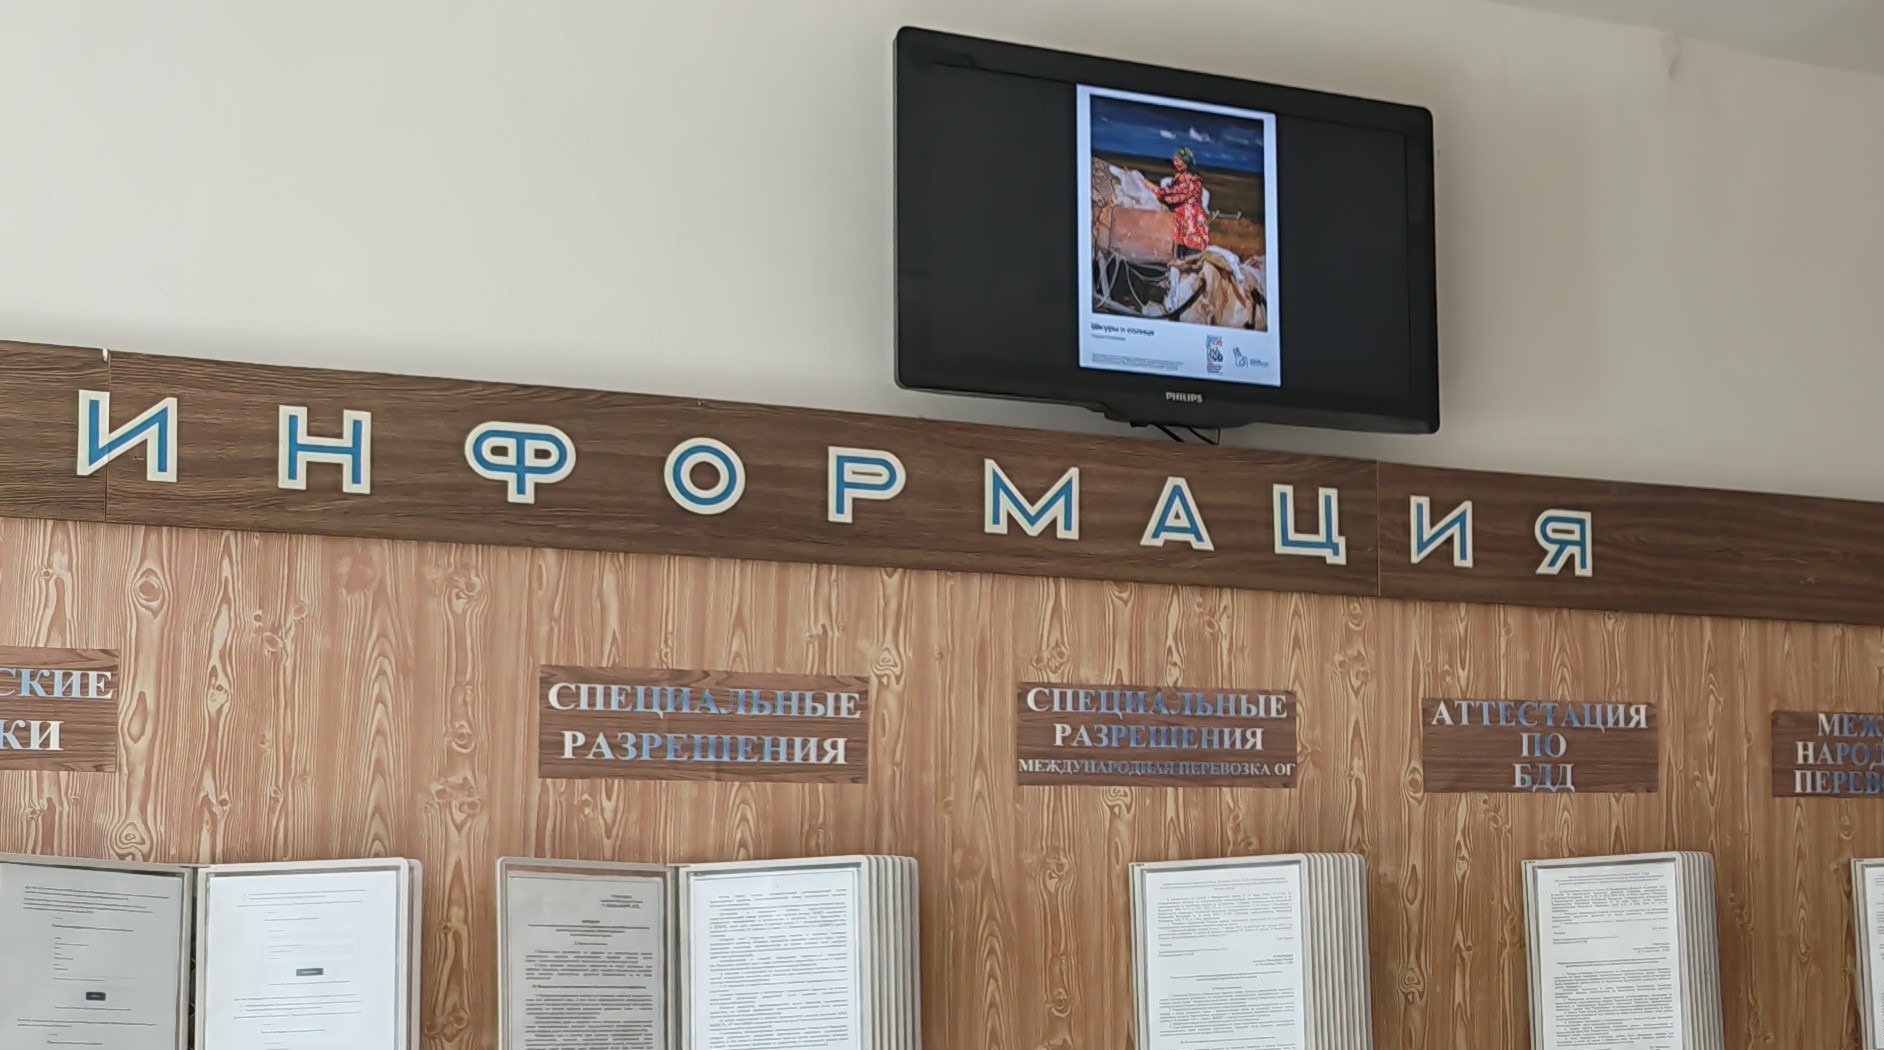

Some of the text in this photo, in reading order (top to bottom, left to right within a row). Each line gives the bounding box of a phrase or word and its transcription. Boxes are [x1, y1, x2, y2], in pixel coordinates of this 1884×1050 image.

[1165, 391, 1203, 404] PHILIPS
[76, 389, 1594, 577] ИНФОРМАЦИЯ
[548, 682, 862, 719] СПЕЦИАЛЬНЫЕ
[1026, 687, 1287, 720] СПЕЦИАЛЬНЫЕ
[1431, 700, 1648, 733] АТТЕСТАЦИЯ
[561, 730, 849, 764] РАЗРЕШЕНИЯ
[1053, 723, 1264, 750] РАЗРЕШЕНИЯ
[1520, 732, 1567, 758] ПО
[1018, 758, 1296, 776] МЕЖДУНАРОДНАЯ ПЕРЕВОЗКА ОГ
[1512, 763, 1575, 793] БДД
